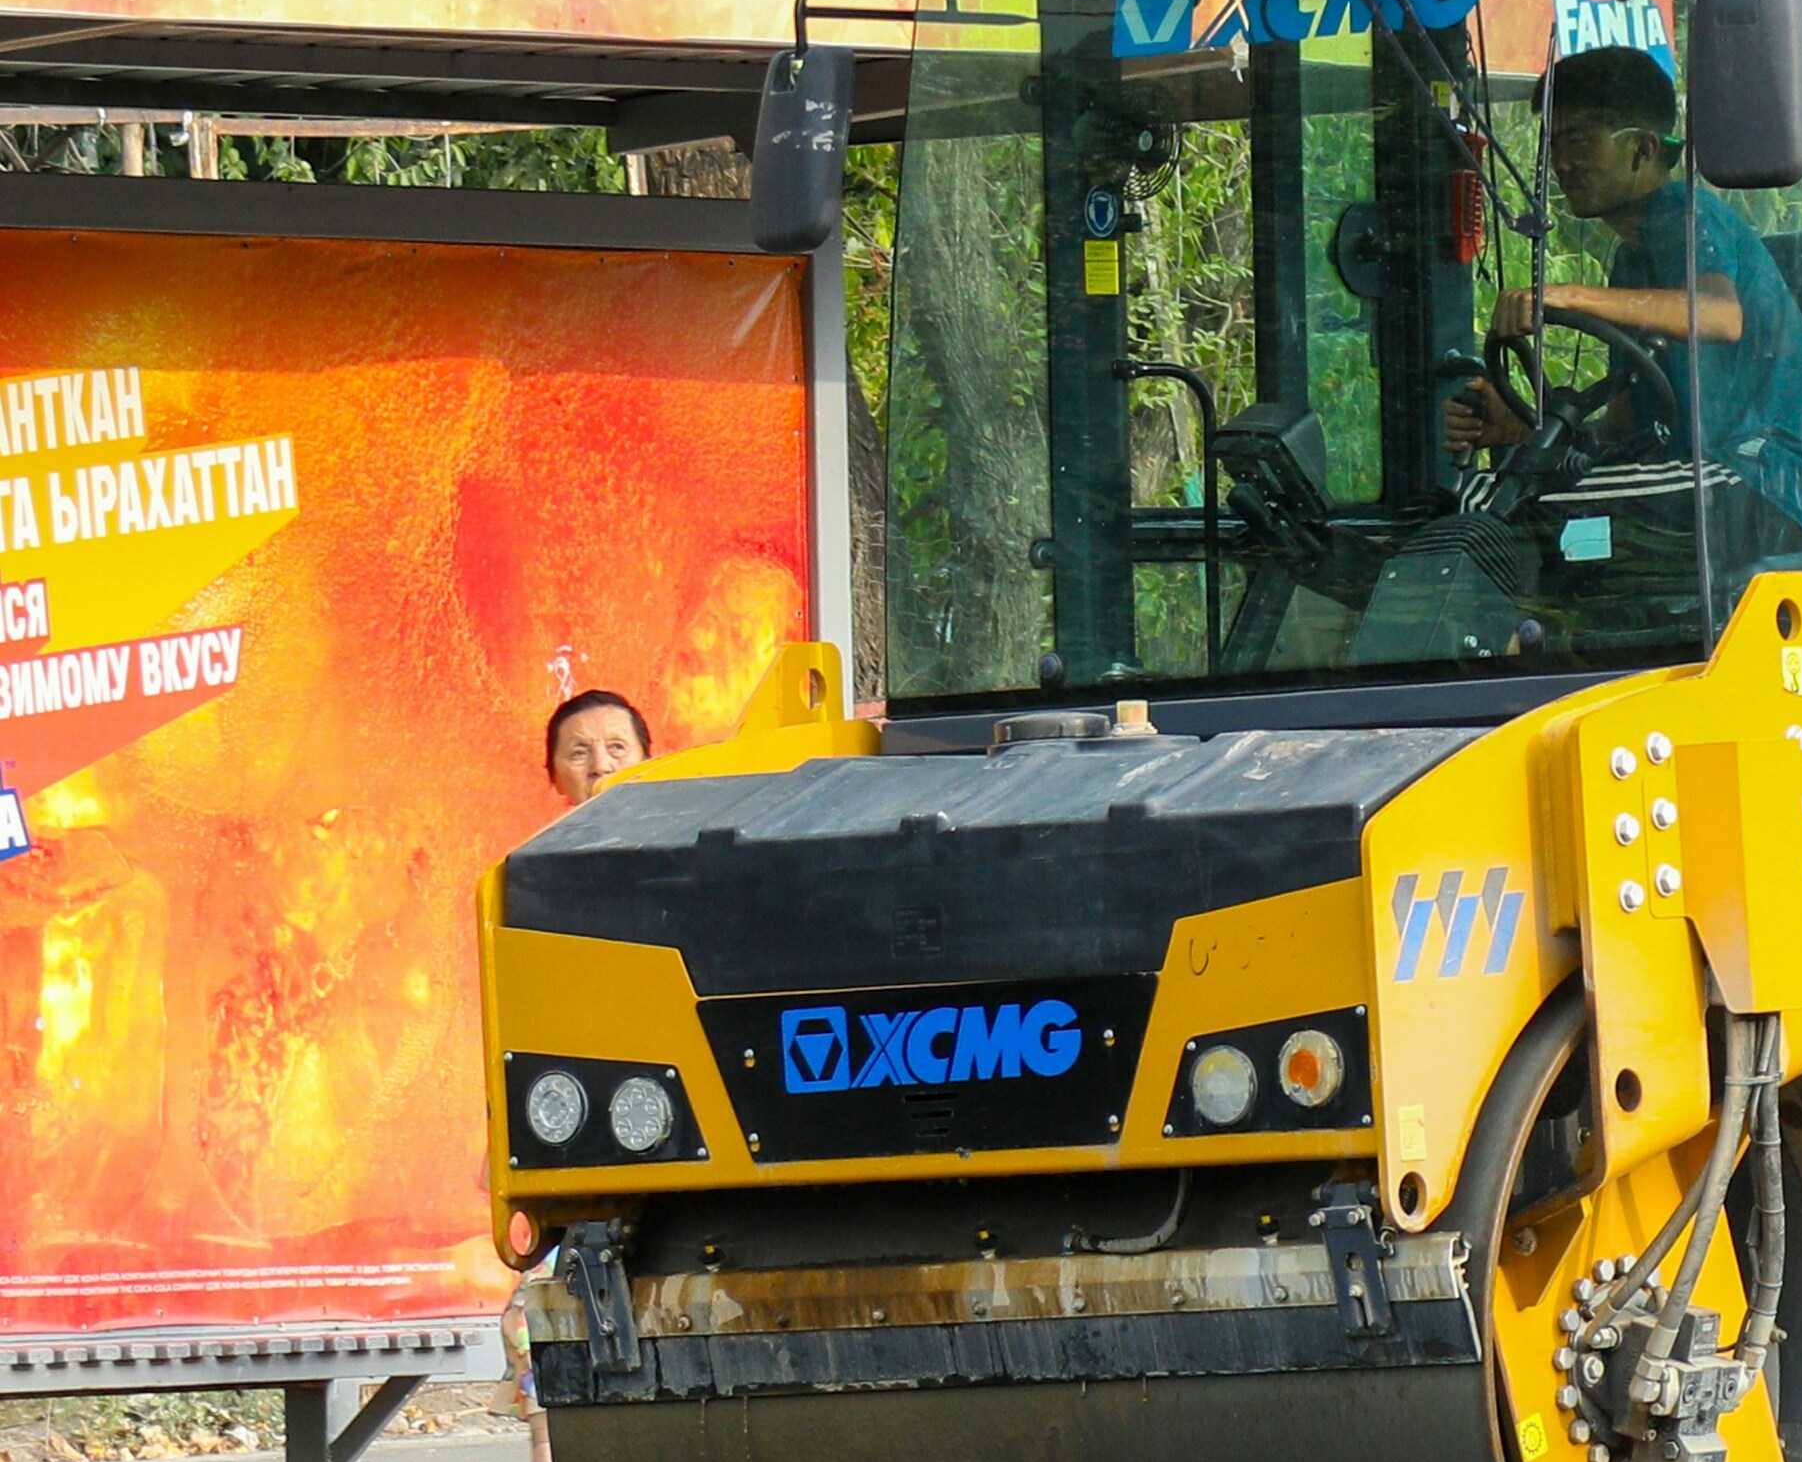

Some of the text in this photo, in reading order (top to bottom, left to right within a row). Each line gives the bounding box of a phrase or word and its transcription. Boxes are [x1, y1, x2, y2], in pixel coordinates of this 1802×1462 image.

[49, 438, 296, 544] ЫРАХАТТАН
[0, 582, 48, 643] СЯ
[140, 628, 241, 696] ВКУСУ
[851, 1000, 1082, 1089] XCMG
